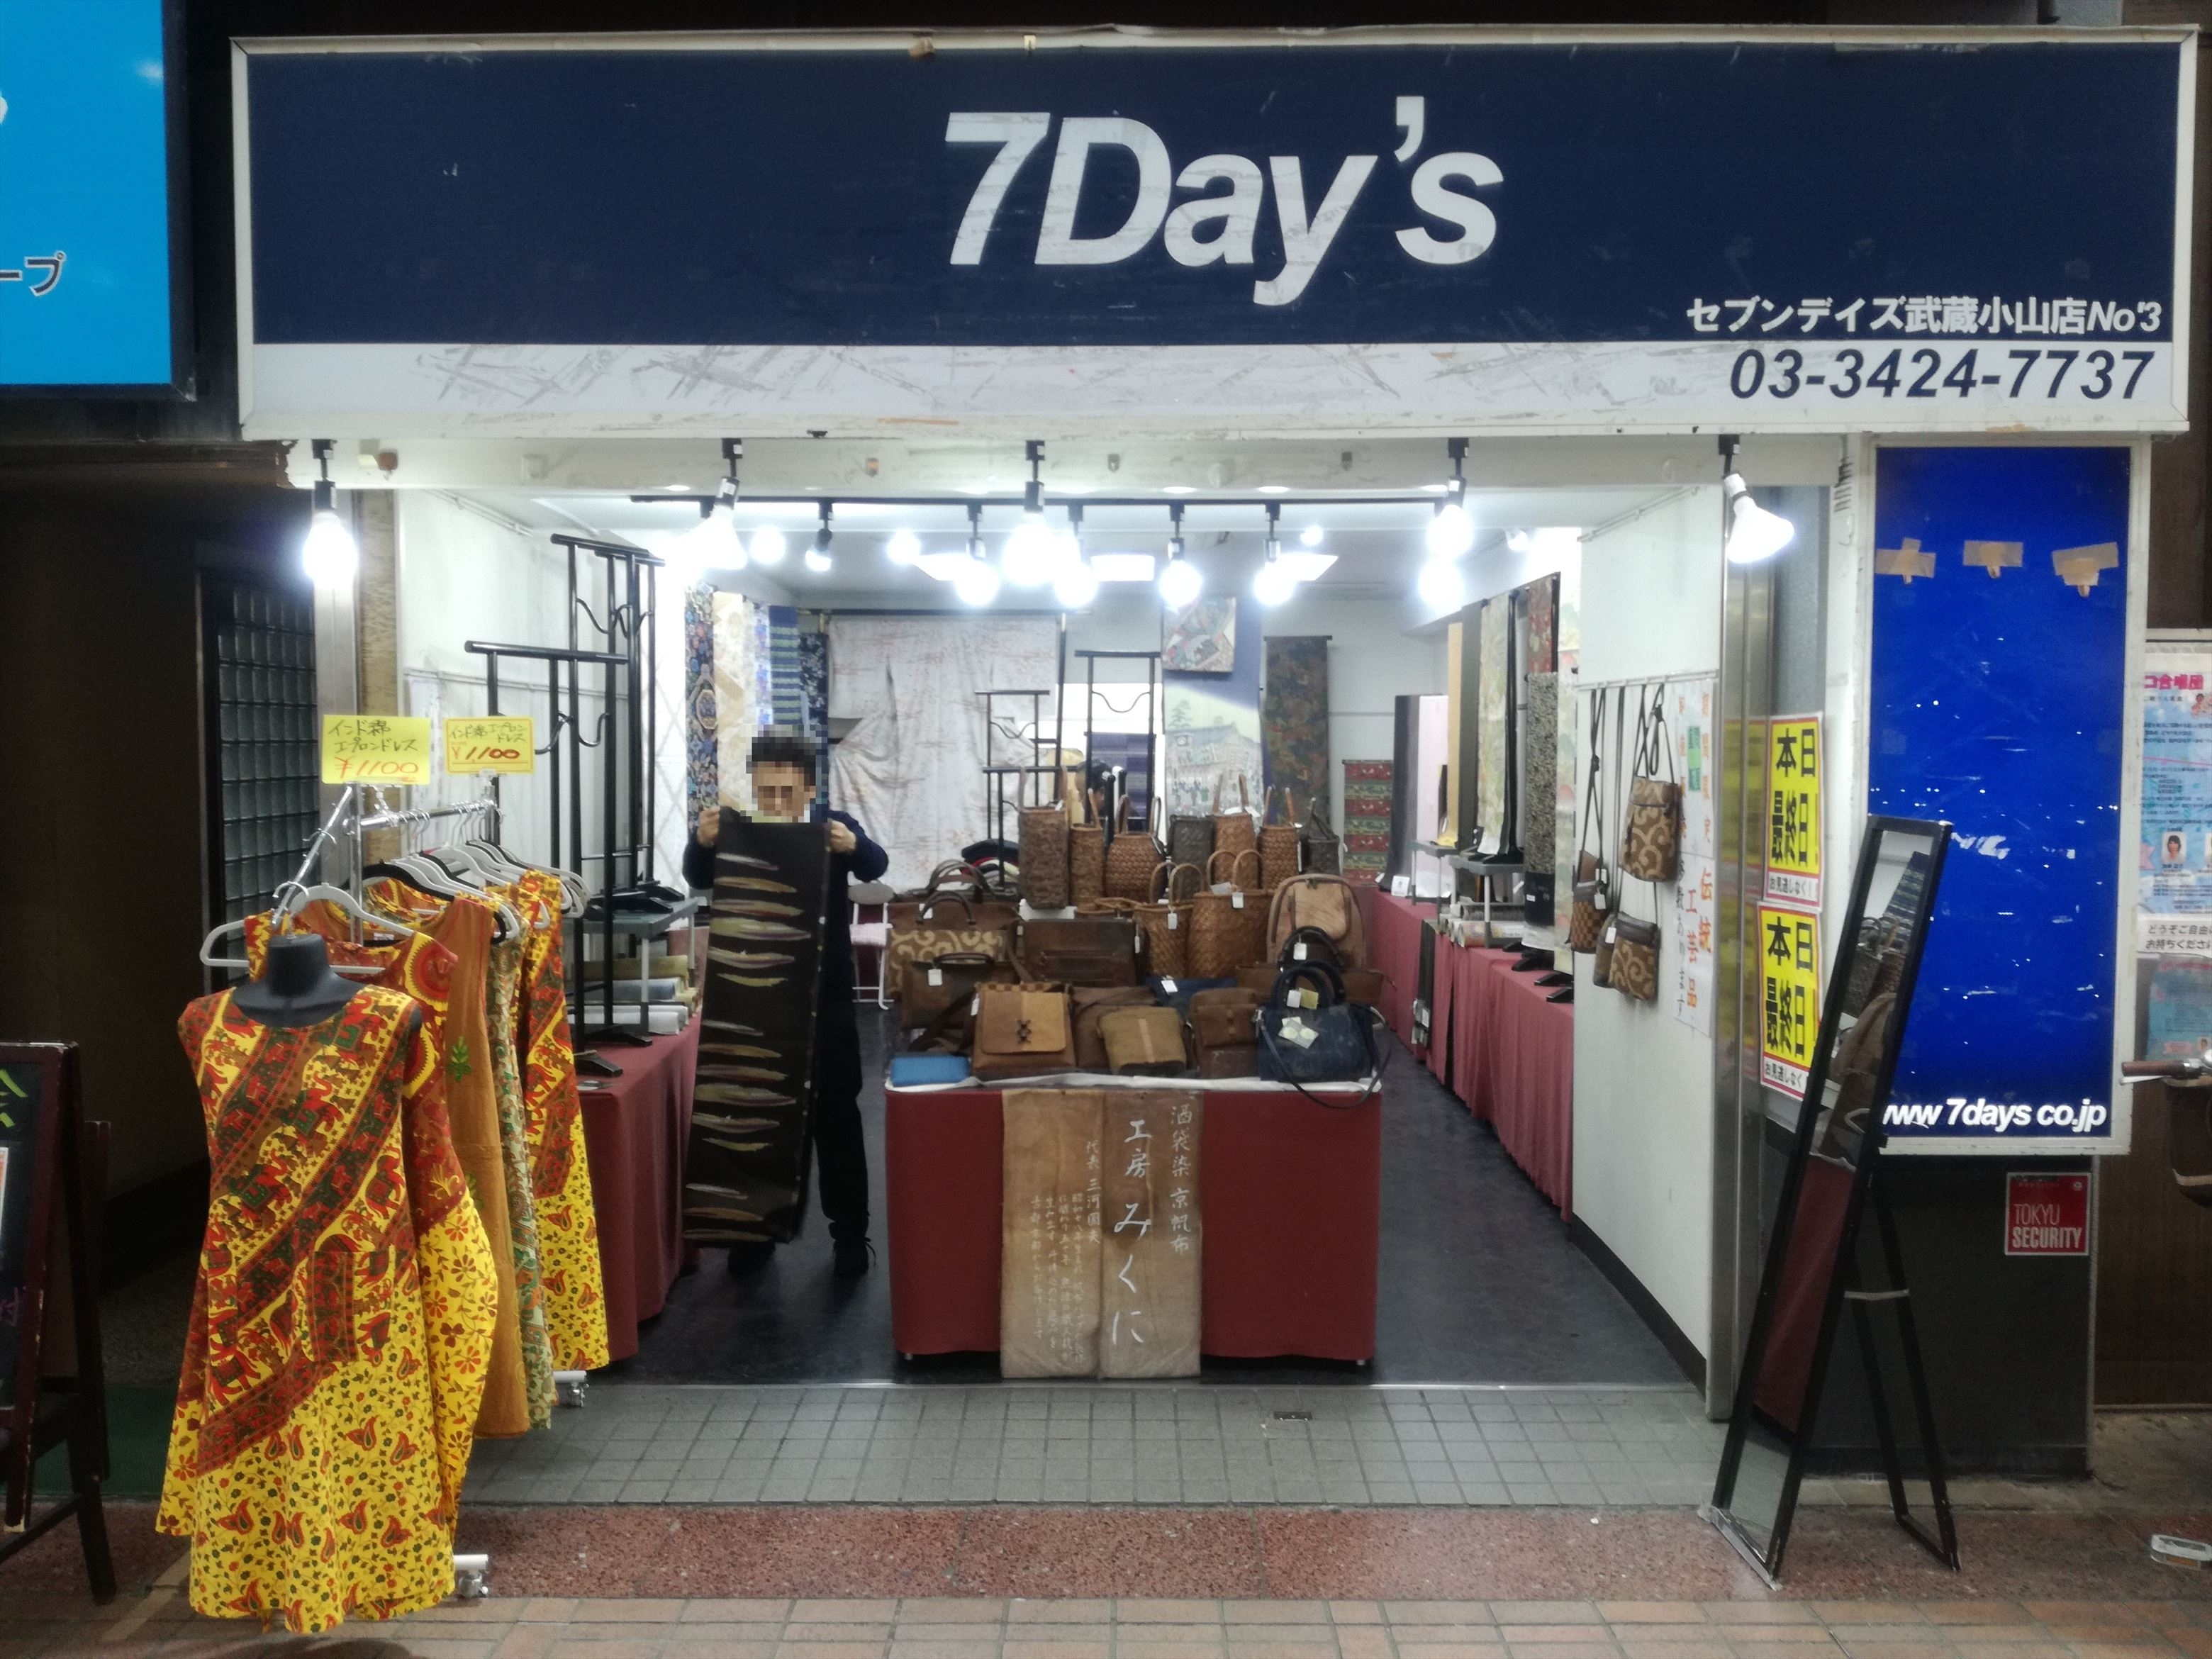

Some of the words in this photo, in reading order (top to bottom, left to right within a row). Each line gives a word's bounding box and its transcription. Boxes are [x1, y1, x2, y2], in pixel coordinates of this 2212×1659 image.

[945, 96, 1504, 306] 7Day's
[1730, 350, 2155, 399] 03-3424-7737
[334, 737, 419, 754] エプロンドレス
[1776, 727, 1816, 778] 本日
[1686, 888, 1698, 1008] 工芸品
[1767, 916, 1814, 973] 本日
[1124, 1119, 1152, 1178] 工房
[2012, 1227, 2083, 1249] SECURITY
[2013, 1203, 2060, 1226] TOKYU
[1113, 1203, 1151, 1346] みくに
